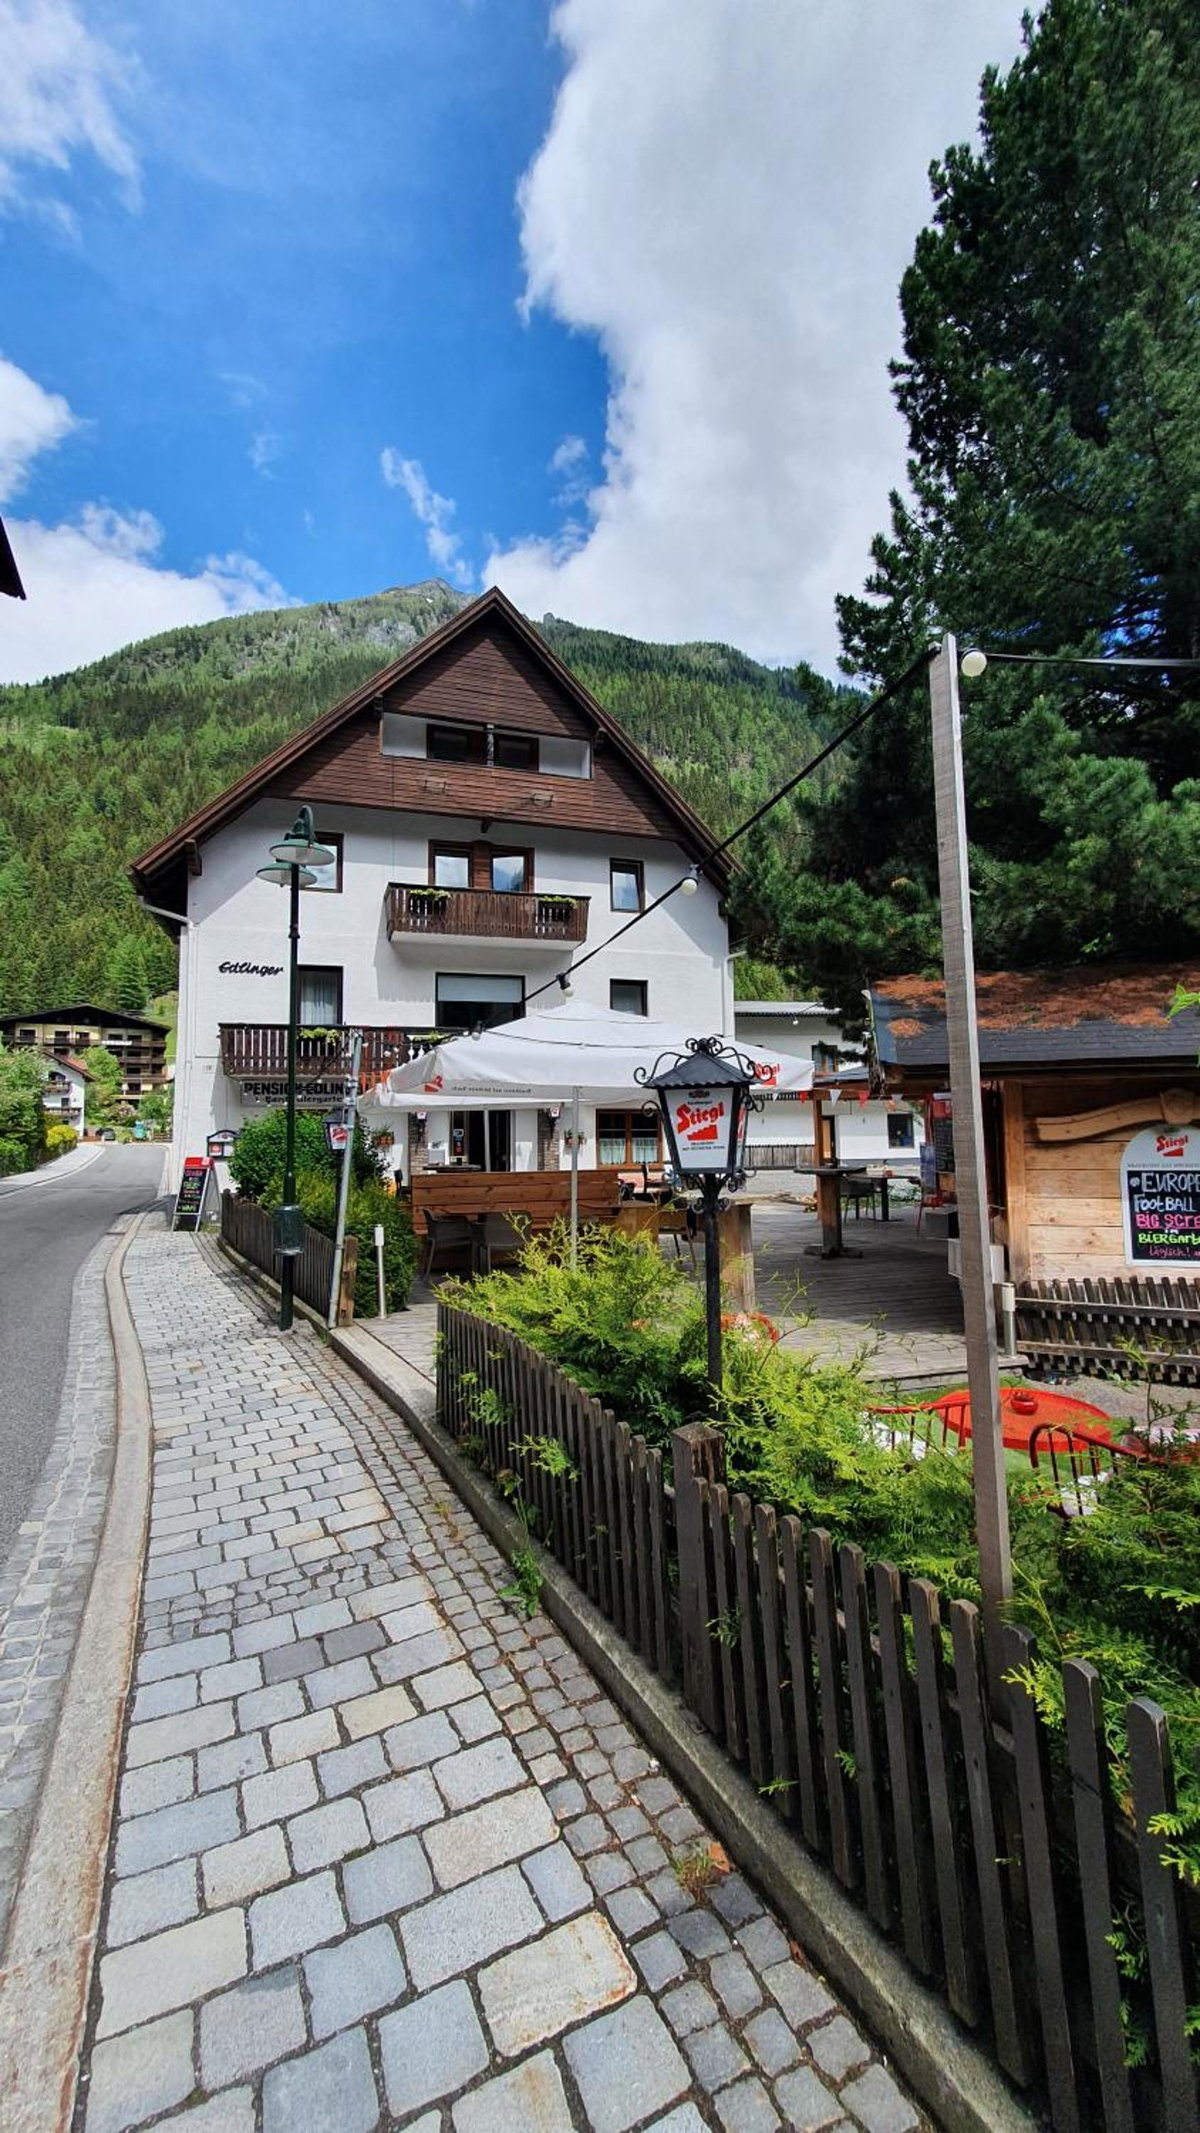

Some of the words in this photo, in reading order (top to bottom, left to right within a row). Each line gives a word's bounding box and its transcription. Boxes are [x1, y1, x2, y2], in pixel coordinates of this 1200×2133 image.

[218, 961, 284, 977] Edlinger
[676, 1101, 725, 1135] Stiegl
[1156, 1134, 1188, 1152] Stiegl
